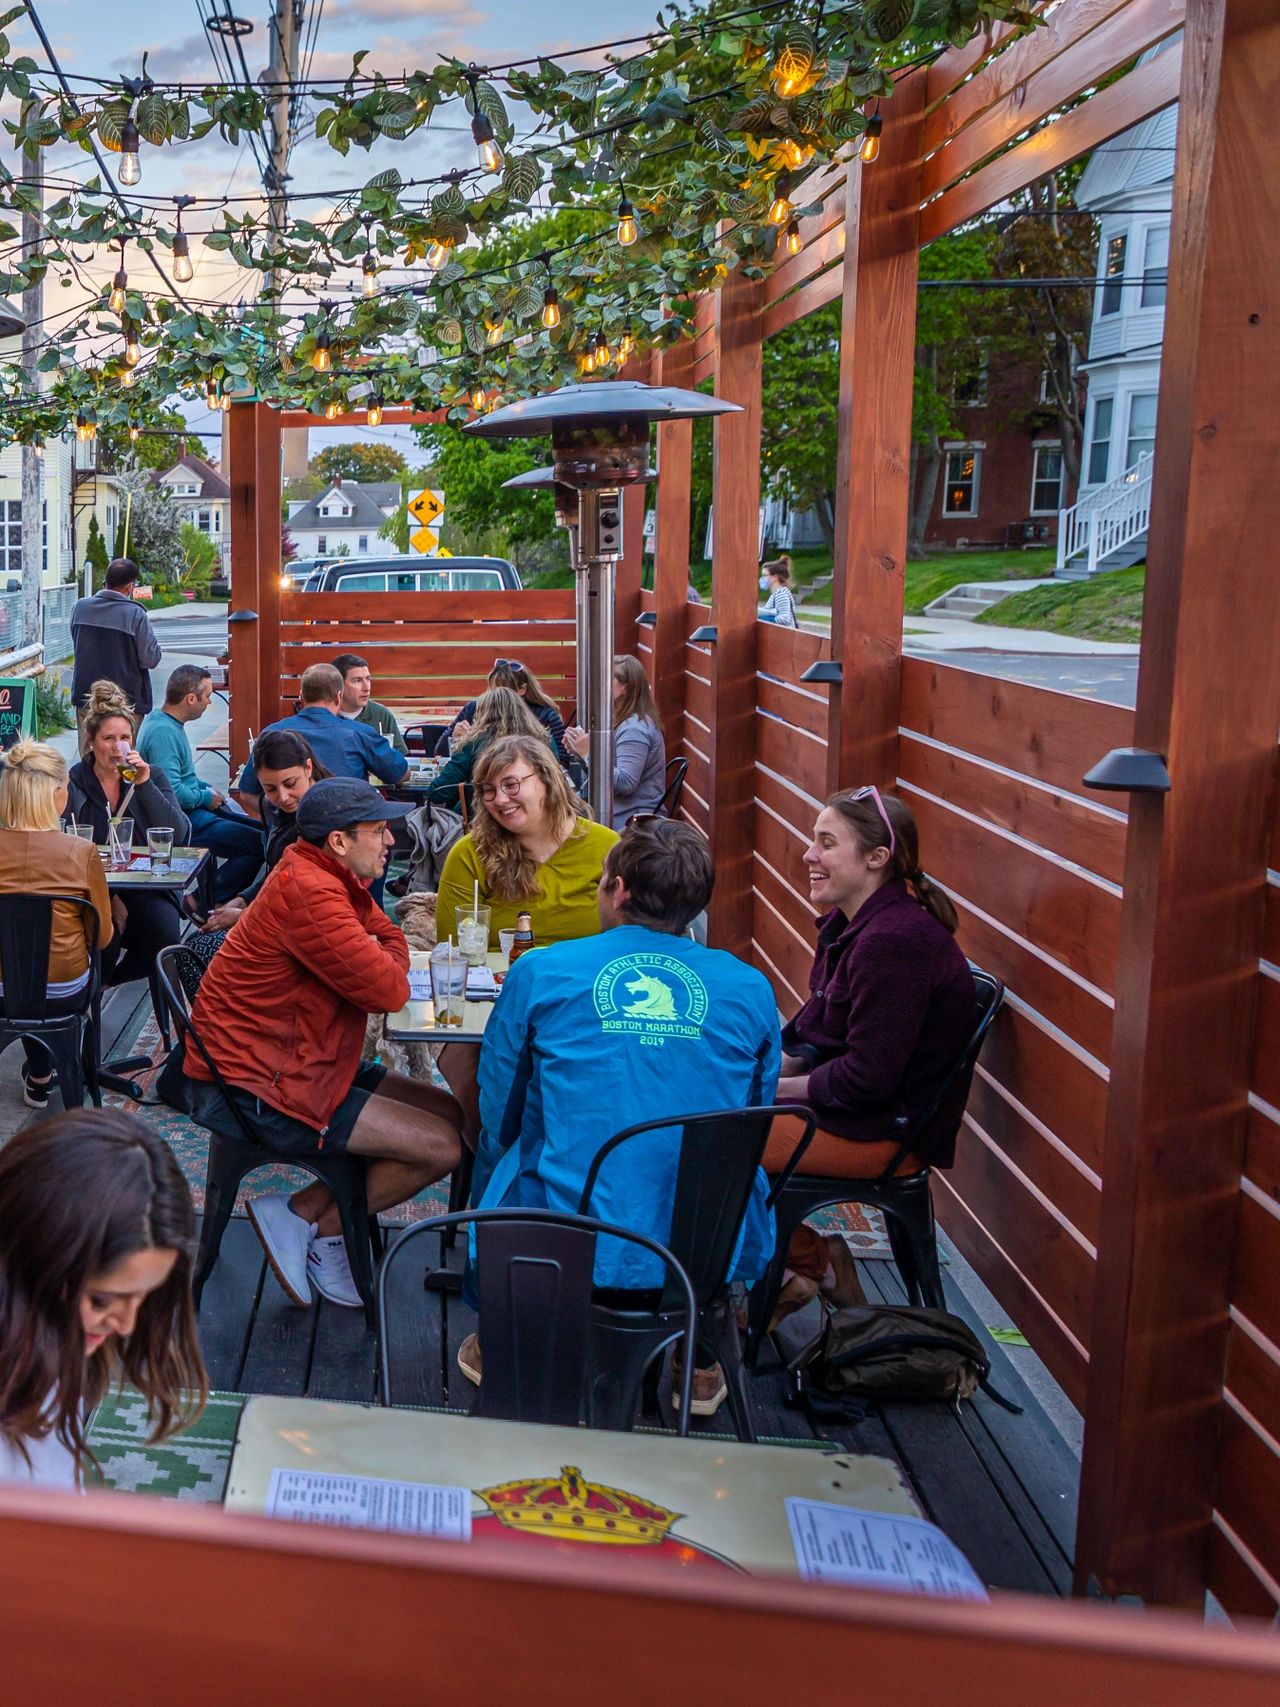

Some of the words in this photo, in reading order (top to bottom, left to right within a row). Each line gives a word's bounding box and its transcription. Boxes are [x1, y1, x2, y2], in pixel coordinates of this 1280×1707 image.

[0, 712, 21, 725] AND
[0, 724, 15, 736] BE
[597, 973, 613, 1012] BOSTON
[608, 955, 662, 975] ATHLETIC
[663, 957, 705, 1019] ASSOCIATION
[602, 1020, 642, 1031] BOSTON
[646, 1023, 700, 1036] MARATHON
[639, 1036, 665, 1046] 2019
